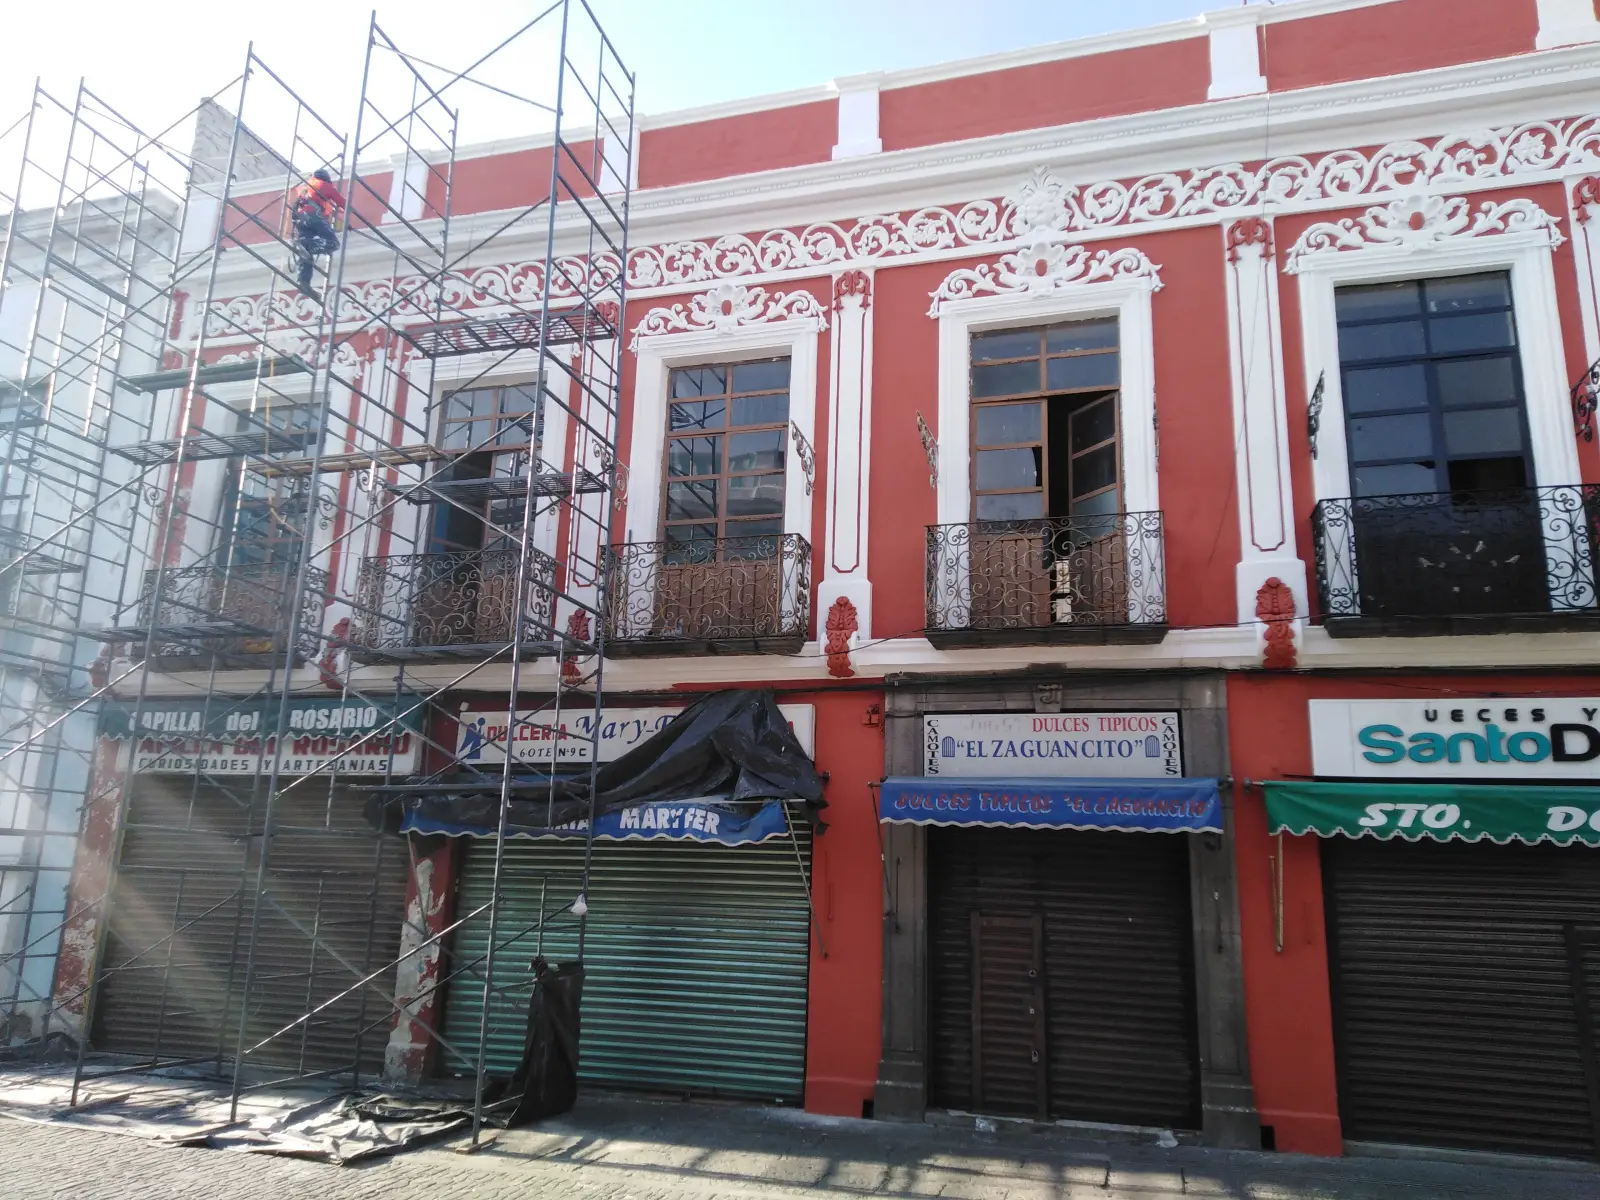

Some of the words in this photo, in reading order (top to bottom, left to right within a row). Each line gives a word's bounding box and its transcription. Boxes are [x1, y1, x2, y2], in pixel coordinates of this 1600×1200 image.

[226, 711, 260, 731] del
[290, 707, 378, 729] ROSARIO
[1032, 717, 1090, 732] DULCES
[1097, 716, 1158, 732] TIPICOS
[1582, 708, 1598, 724] Y
[927, 719, 940, 775] CAMOTES
[1161, 717, 1179, 776] CAMOTES
[264, 760, 272, 770] Y
